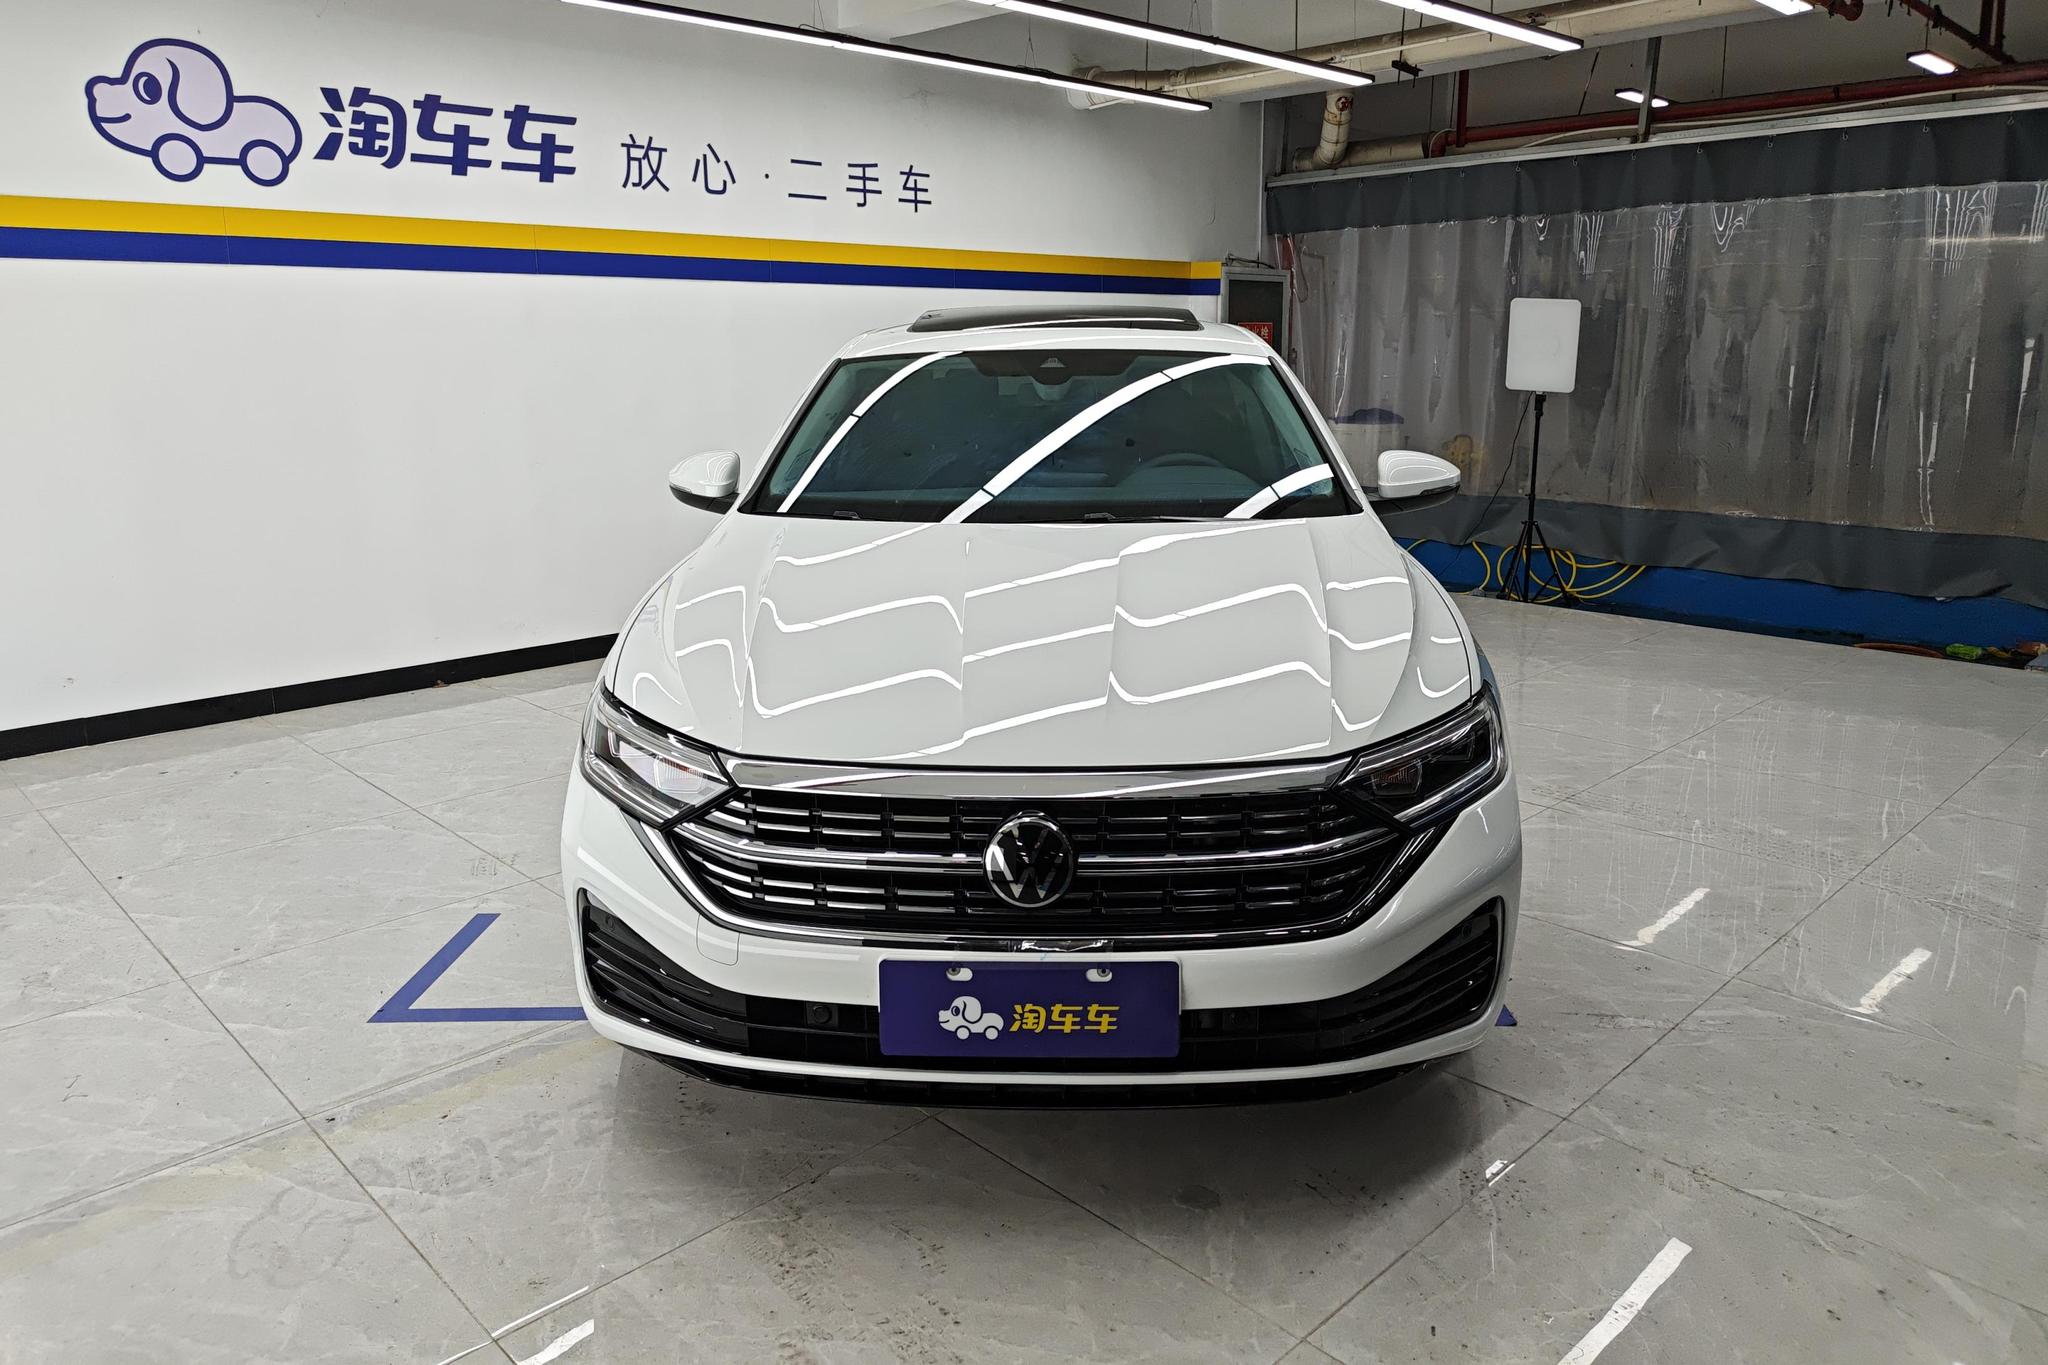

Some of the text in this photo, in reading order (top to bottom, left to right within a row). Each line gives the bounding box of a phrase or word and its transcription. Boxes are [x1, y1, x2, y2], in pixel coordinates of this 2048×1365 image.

[313, 86, 578, 183] 淘车车
[1009, 1003, 1121, 1034] 淘车车
